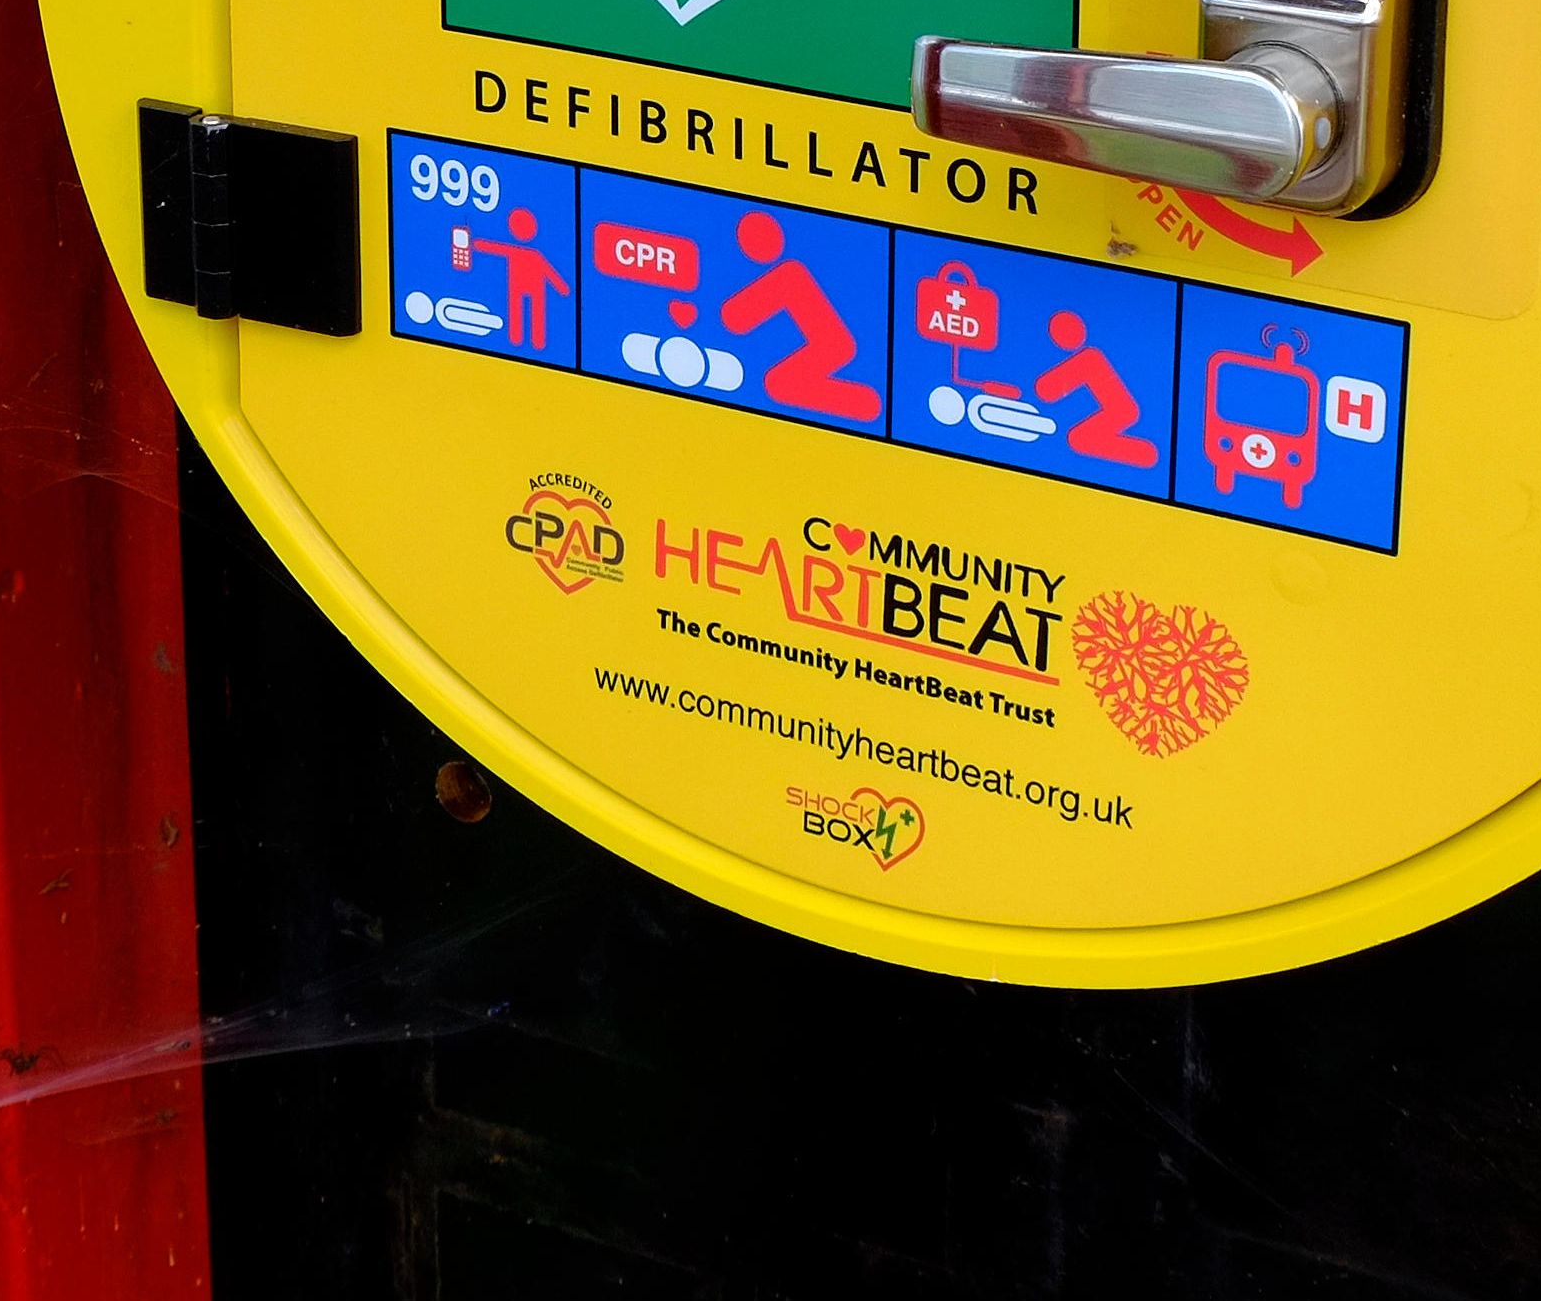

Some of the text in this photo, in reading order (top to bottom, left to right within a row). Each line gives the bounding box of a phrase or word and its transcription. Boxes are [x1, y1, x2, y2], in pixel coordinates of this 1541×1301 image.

[472, 70, 1039, 216] DEFIBRILLATOR
[409, 154, 500, 214] 999
[1127, 178, 1205, 251] PEN
[614, 238, 678, 277] CPR
[929, 308, 980, 340] AED
[1337, 388, 1374, 433] H
[529, 473, 612, 510] ACCREDITED
[505, 510, 624, 566] CPAD
[657, 609, 1056, 728] The Community HeartBeat Trust
[594, 666, 1134, 829] www.communityheartbeat.org.uk
[786, 786, 875, 826] SHOCK
[804, 810, 876, 852] BOX
